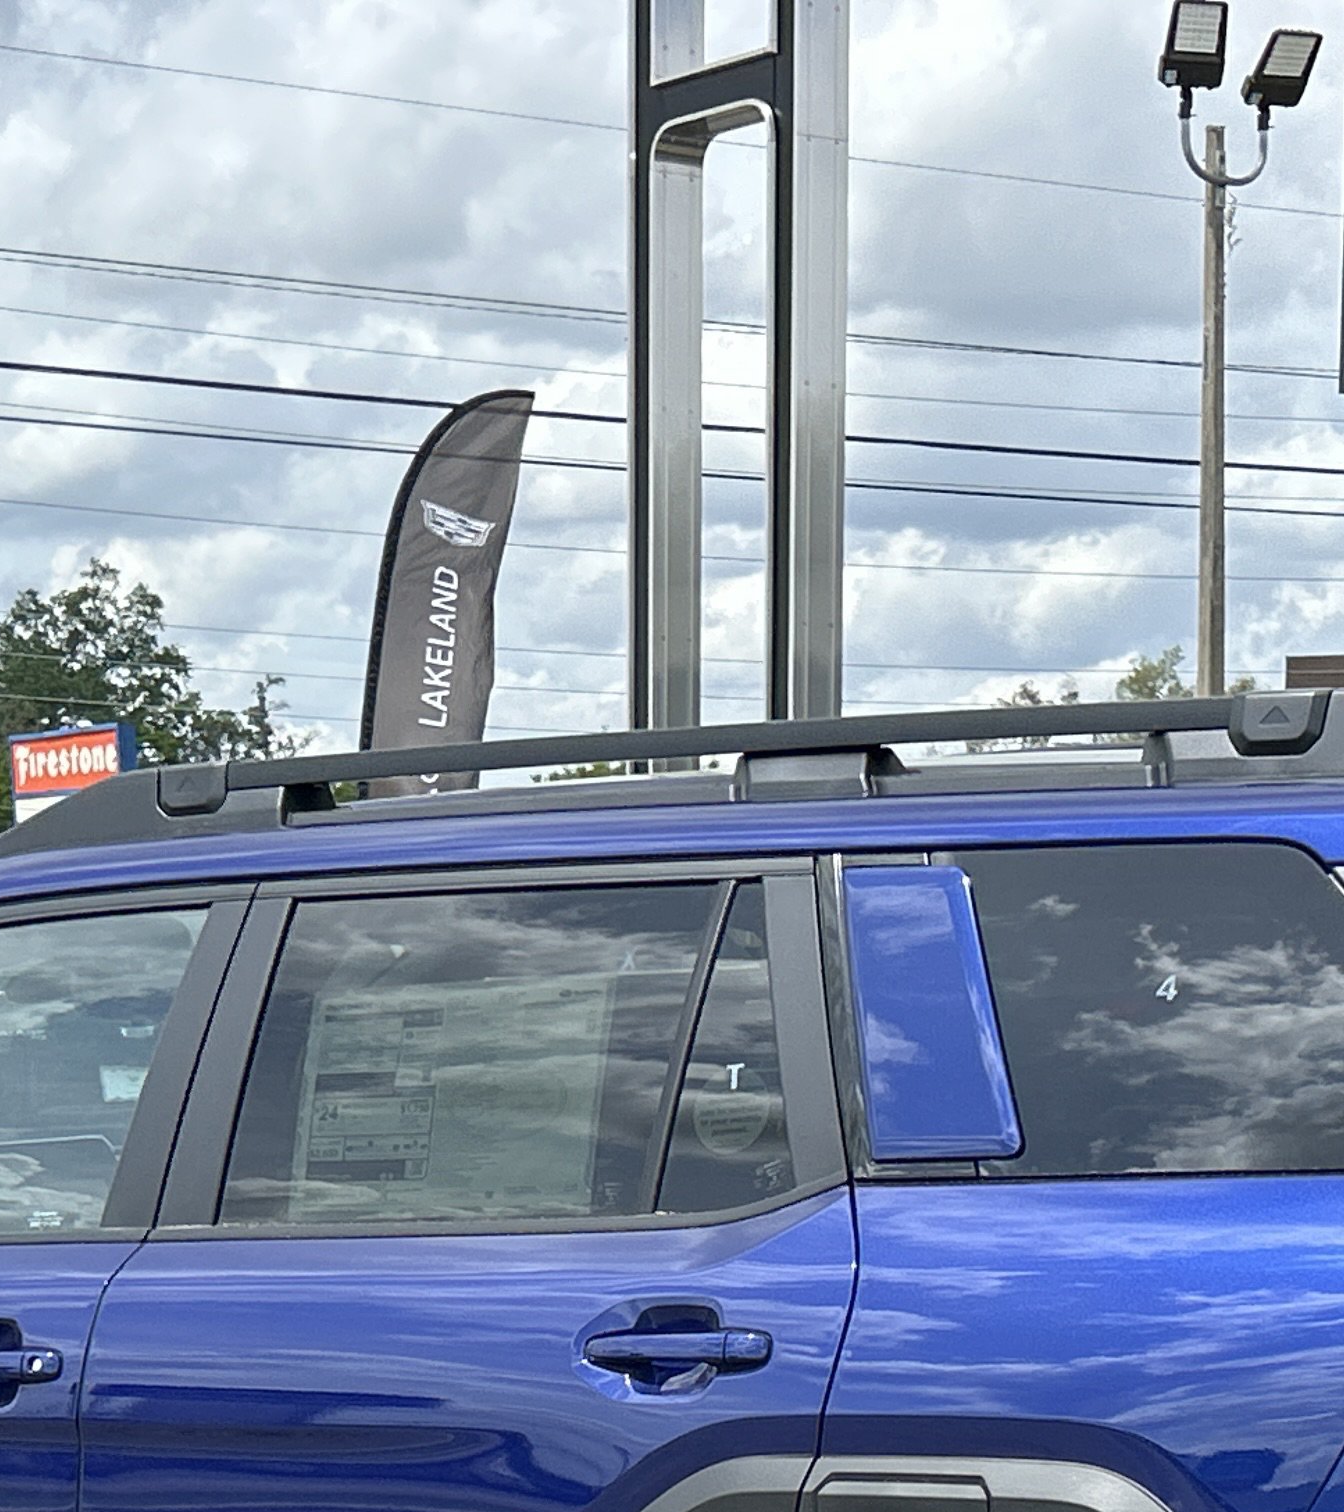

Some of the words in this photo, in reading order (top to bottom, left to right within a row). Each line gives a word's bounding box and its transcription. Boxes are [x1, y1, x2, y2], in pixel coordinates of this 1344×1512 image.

[418, 566, 459, 728] LAKELAND
[15, 743, 117, 787] Firestone
[1156, 974, 1178, 1001] 4
[725, 1062, 745, 1090] T
